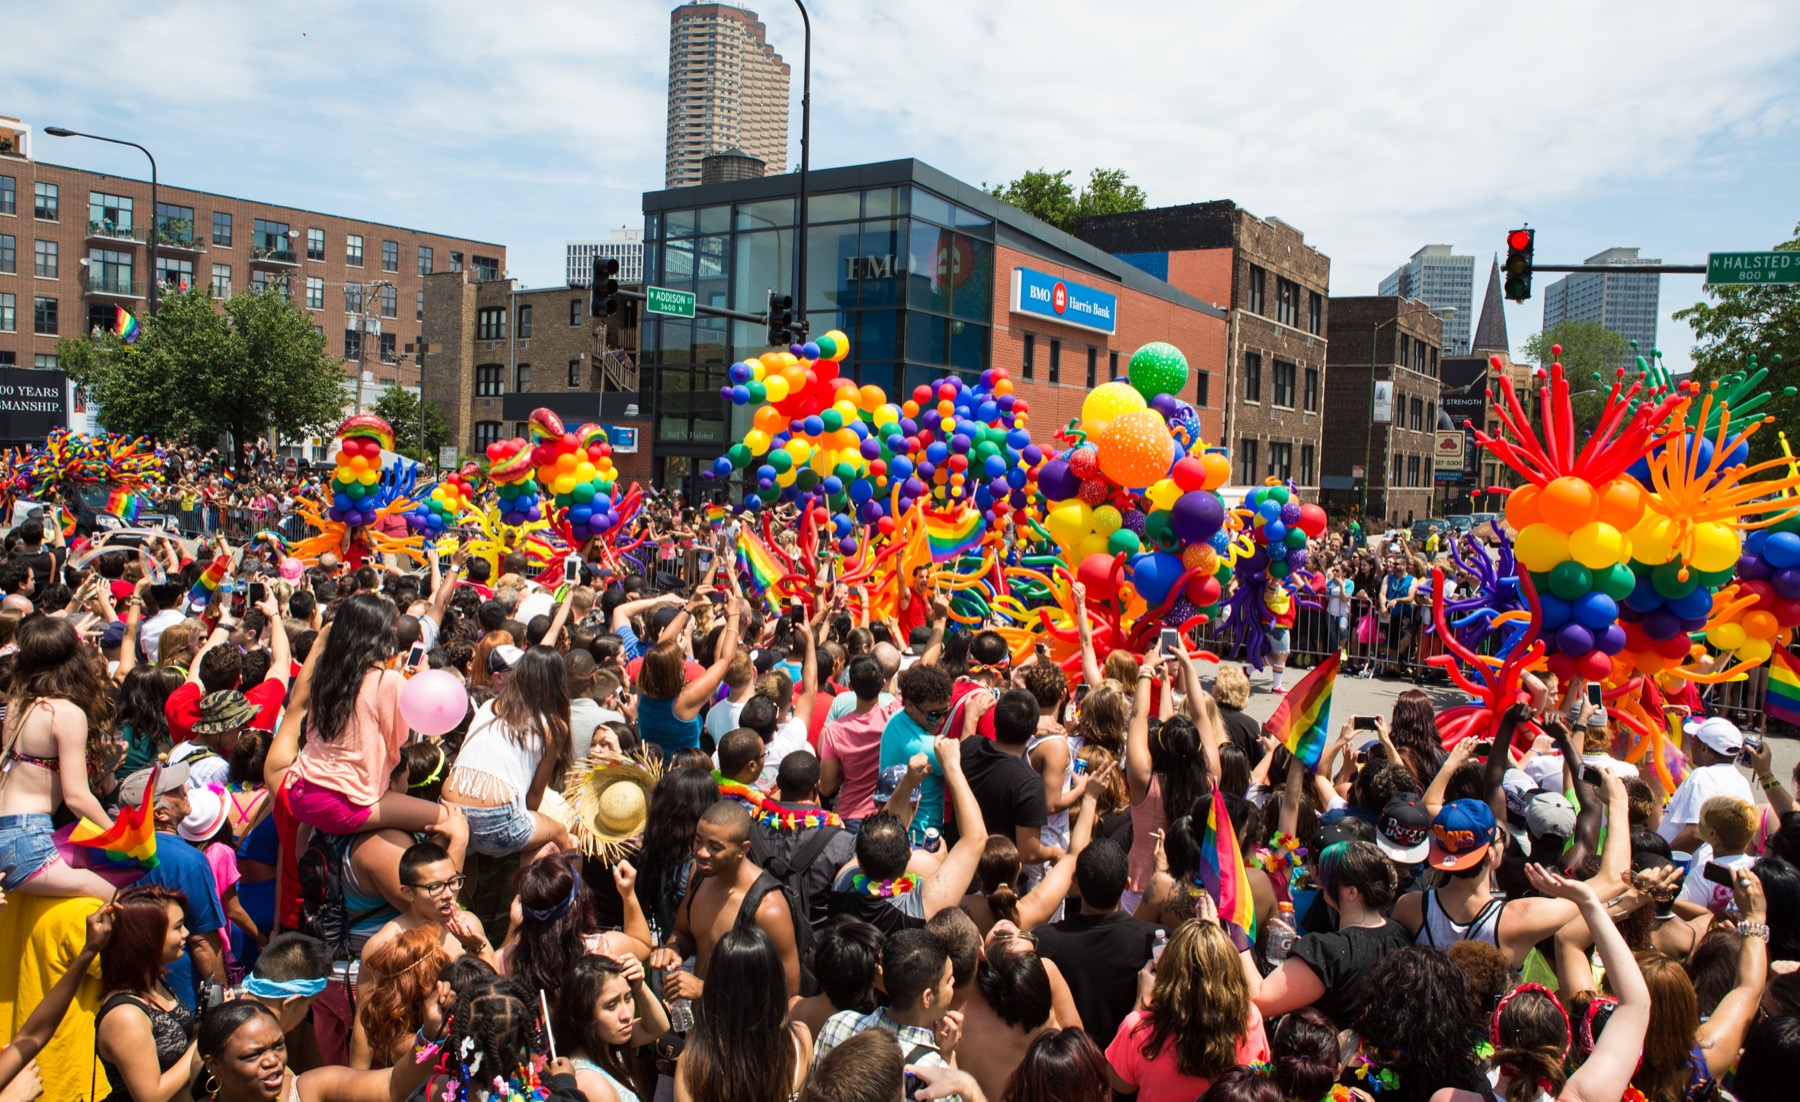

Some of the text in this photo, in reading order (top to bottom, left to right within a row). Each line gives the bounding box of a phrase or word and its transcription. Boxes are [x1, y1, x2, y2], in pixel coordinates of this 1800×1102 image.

[1713, 259, 1719, 267] N
[1724, 256, 1790, 269] HALSTED
[1739, 271, 1777, 280] 800 W
[656, 291, 686, 305] ADDISON
[687, 297, 693, 305] ST
[1030, 285, 1110, 319] BMO Harris Bank
[660, 303, 676, 312] 3600
[18, 386, 59, 398] YEARS
[1281, 938, 1291, 950] G
